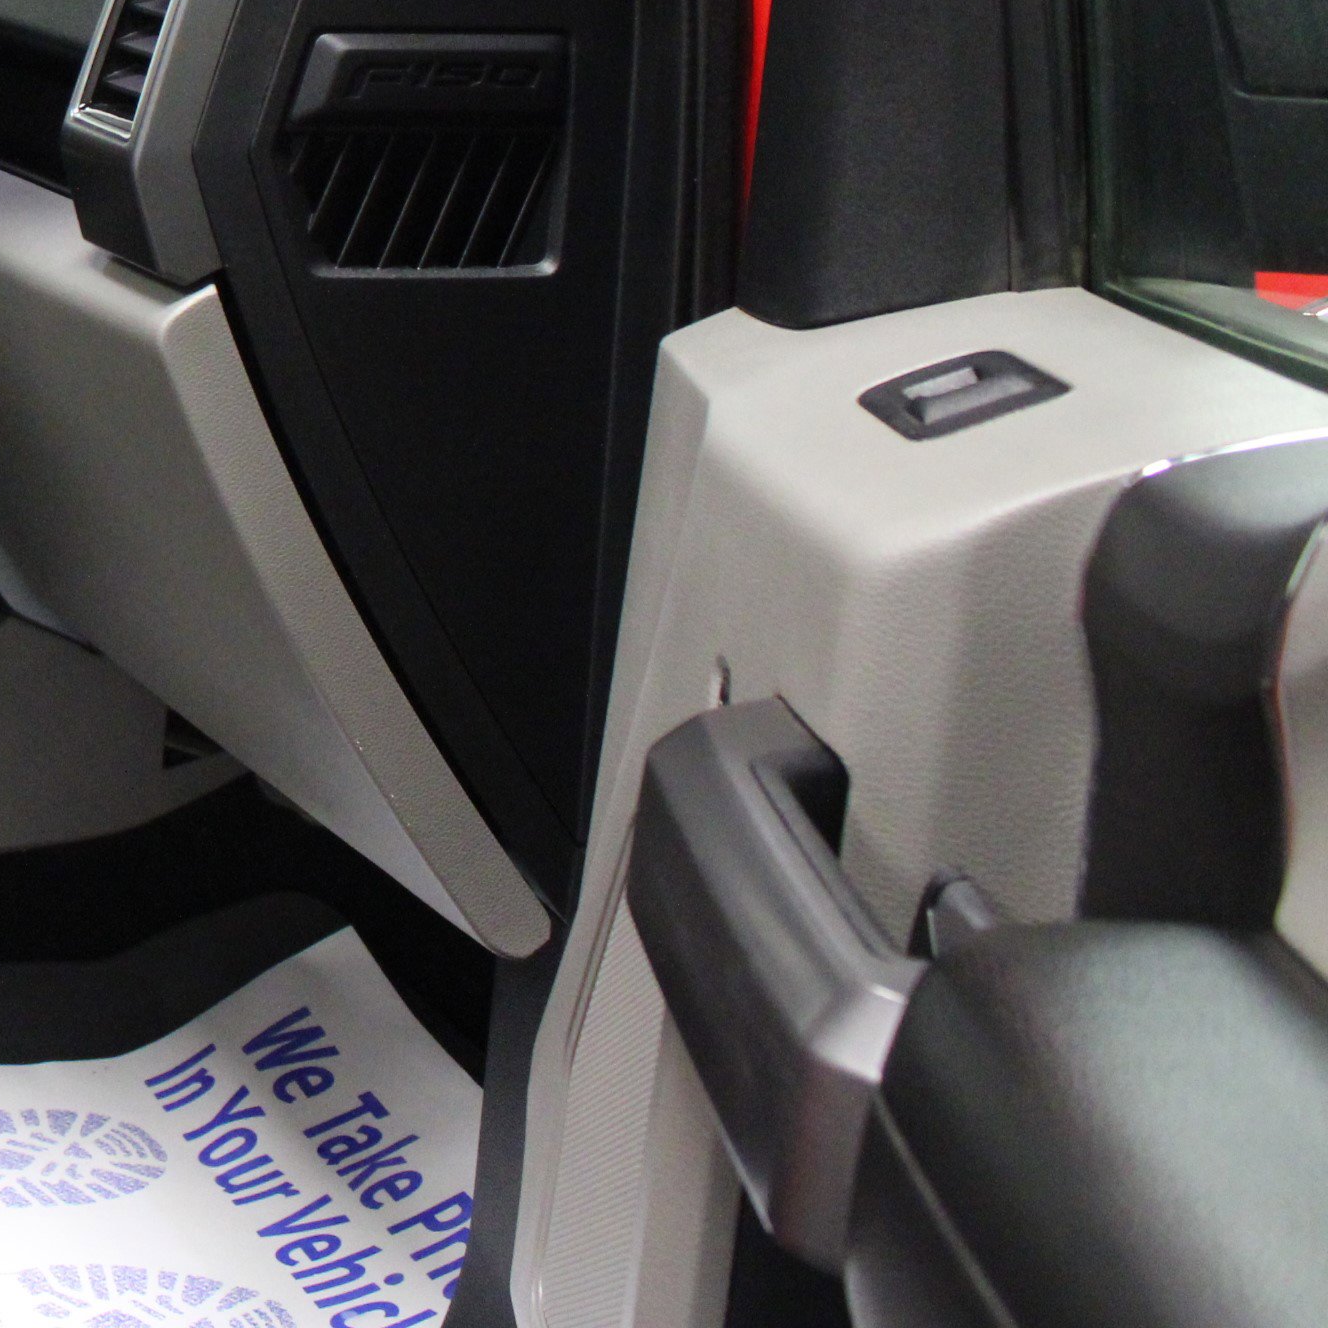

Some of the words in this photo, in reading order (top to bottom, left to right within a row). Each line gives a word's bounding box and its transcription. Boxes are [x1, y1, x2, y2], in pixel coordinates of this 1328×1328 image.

[144, 1043, 217, 1112] In
[182, 1085, 300, 1206] Your
[242, 1006, 340, 1103] We
[303, 1091, 423, 1209] Take
[387, 1191, 473, 1300] Pri
